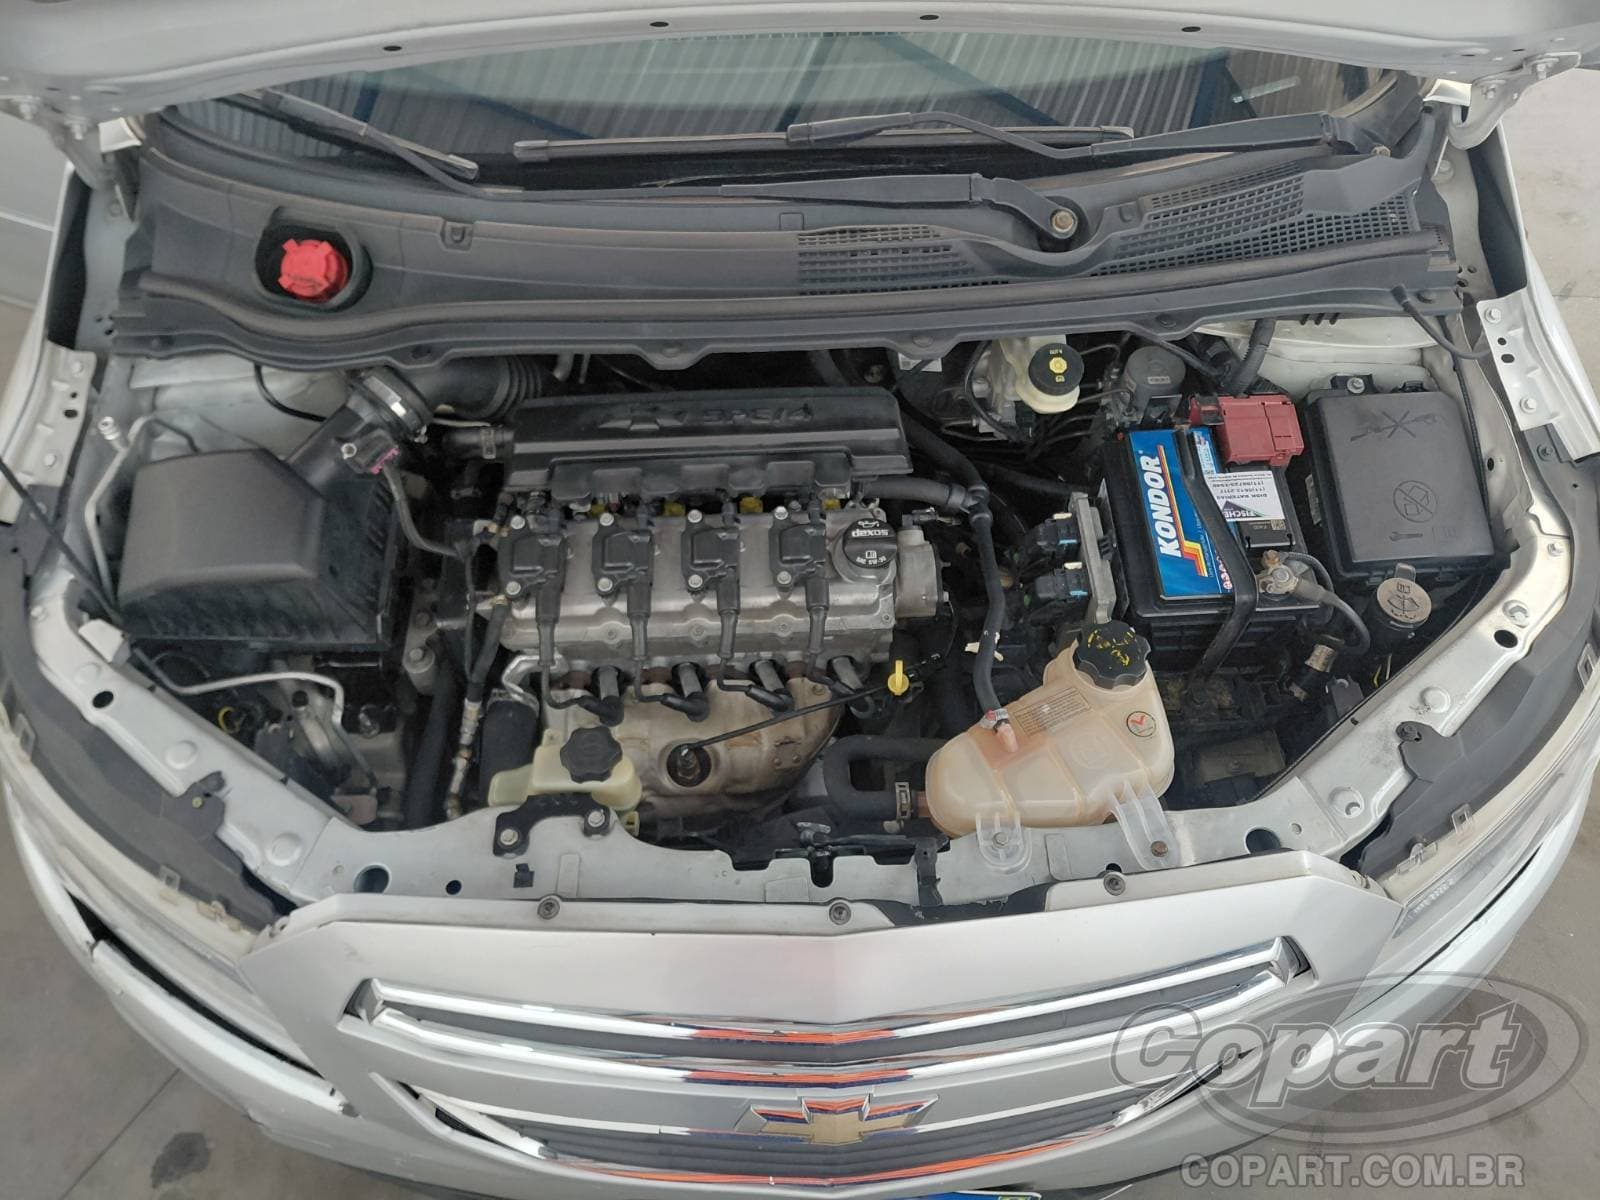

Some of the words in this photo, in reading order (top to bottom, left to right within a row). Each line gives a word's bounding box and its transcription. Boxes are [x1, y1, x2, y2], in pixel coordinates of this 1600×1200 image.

[1140, 455, 1181, 557] KONDOR
[1222, 510, 1256, 518] FISCHE
[852, 529, 888, 537] dexos
